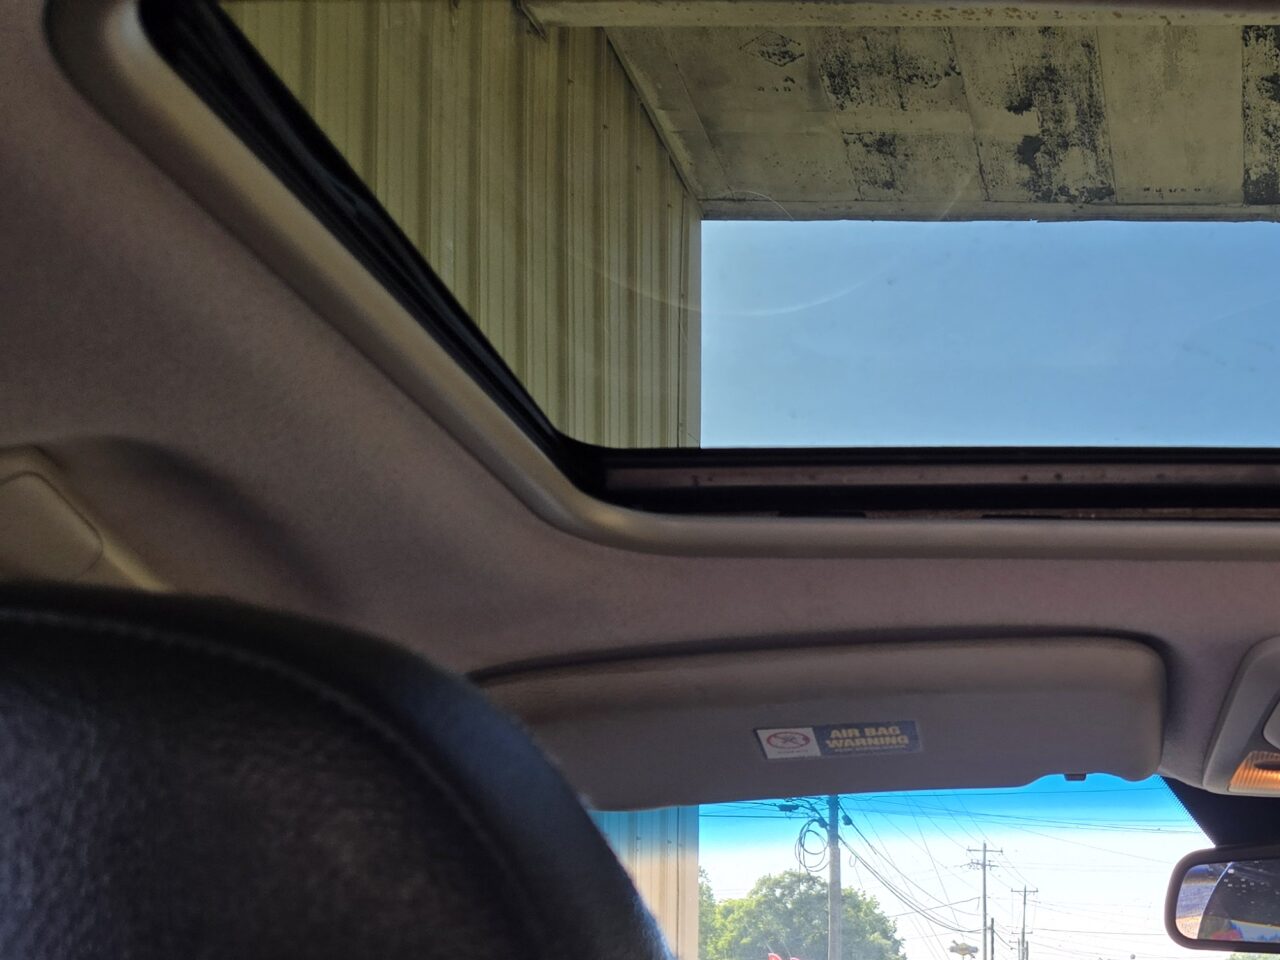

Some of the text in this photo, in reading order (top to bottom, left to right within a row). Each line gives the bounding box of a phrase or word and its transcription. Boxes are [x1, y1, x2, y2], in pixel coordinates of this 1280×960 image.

[829, 726, 901, 738] AIR BAG
[825, 735, 909, 748] WARNING
